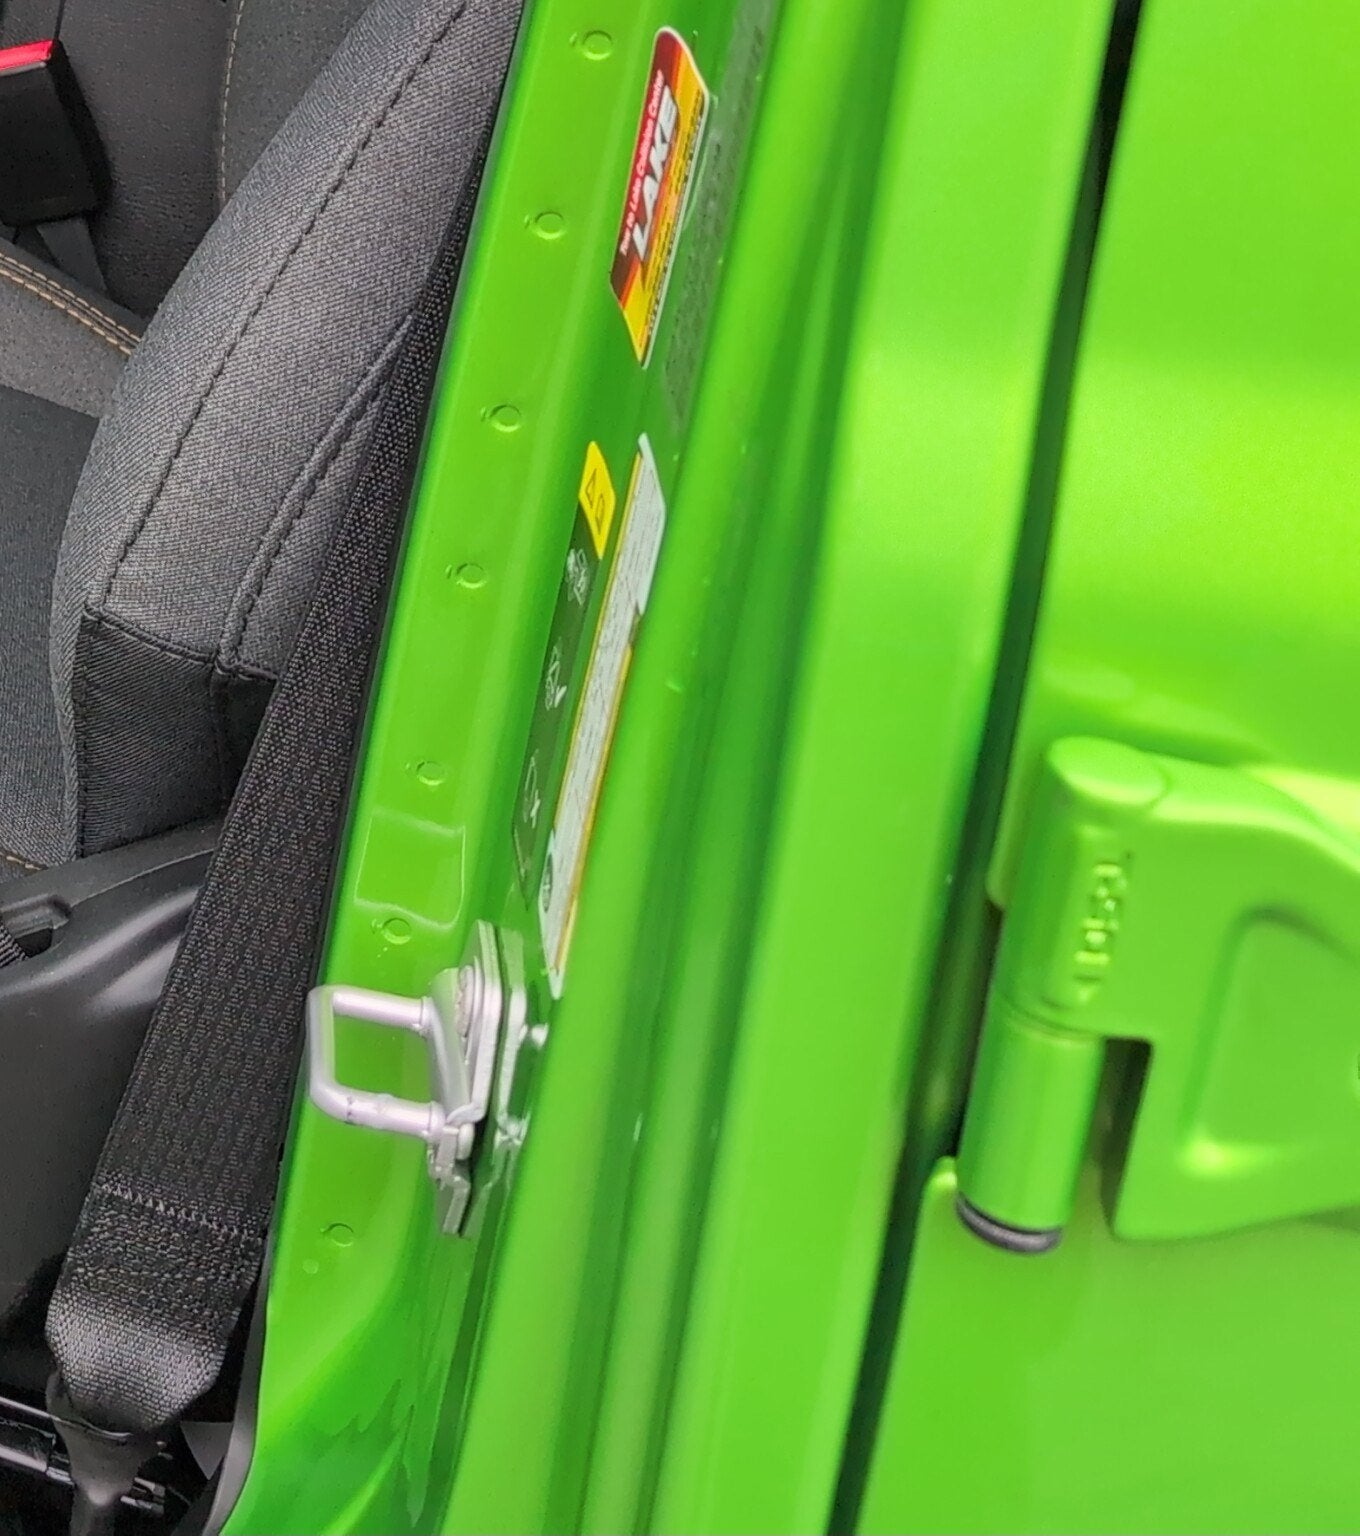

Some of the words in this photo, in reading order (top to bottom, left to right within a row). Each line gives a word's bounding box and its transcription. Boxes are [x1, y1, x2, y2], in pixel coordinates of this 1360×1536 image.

[648, 69, 665, 119] Center
[632, 83, 678, 262] LAKE
[636, 117, 654, 178] Collision
[629, 177, 642, 213] Lake
[626, 212, 636, 229] to
